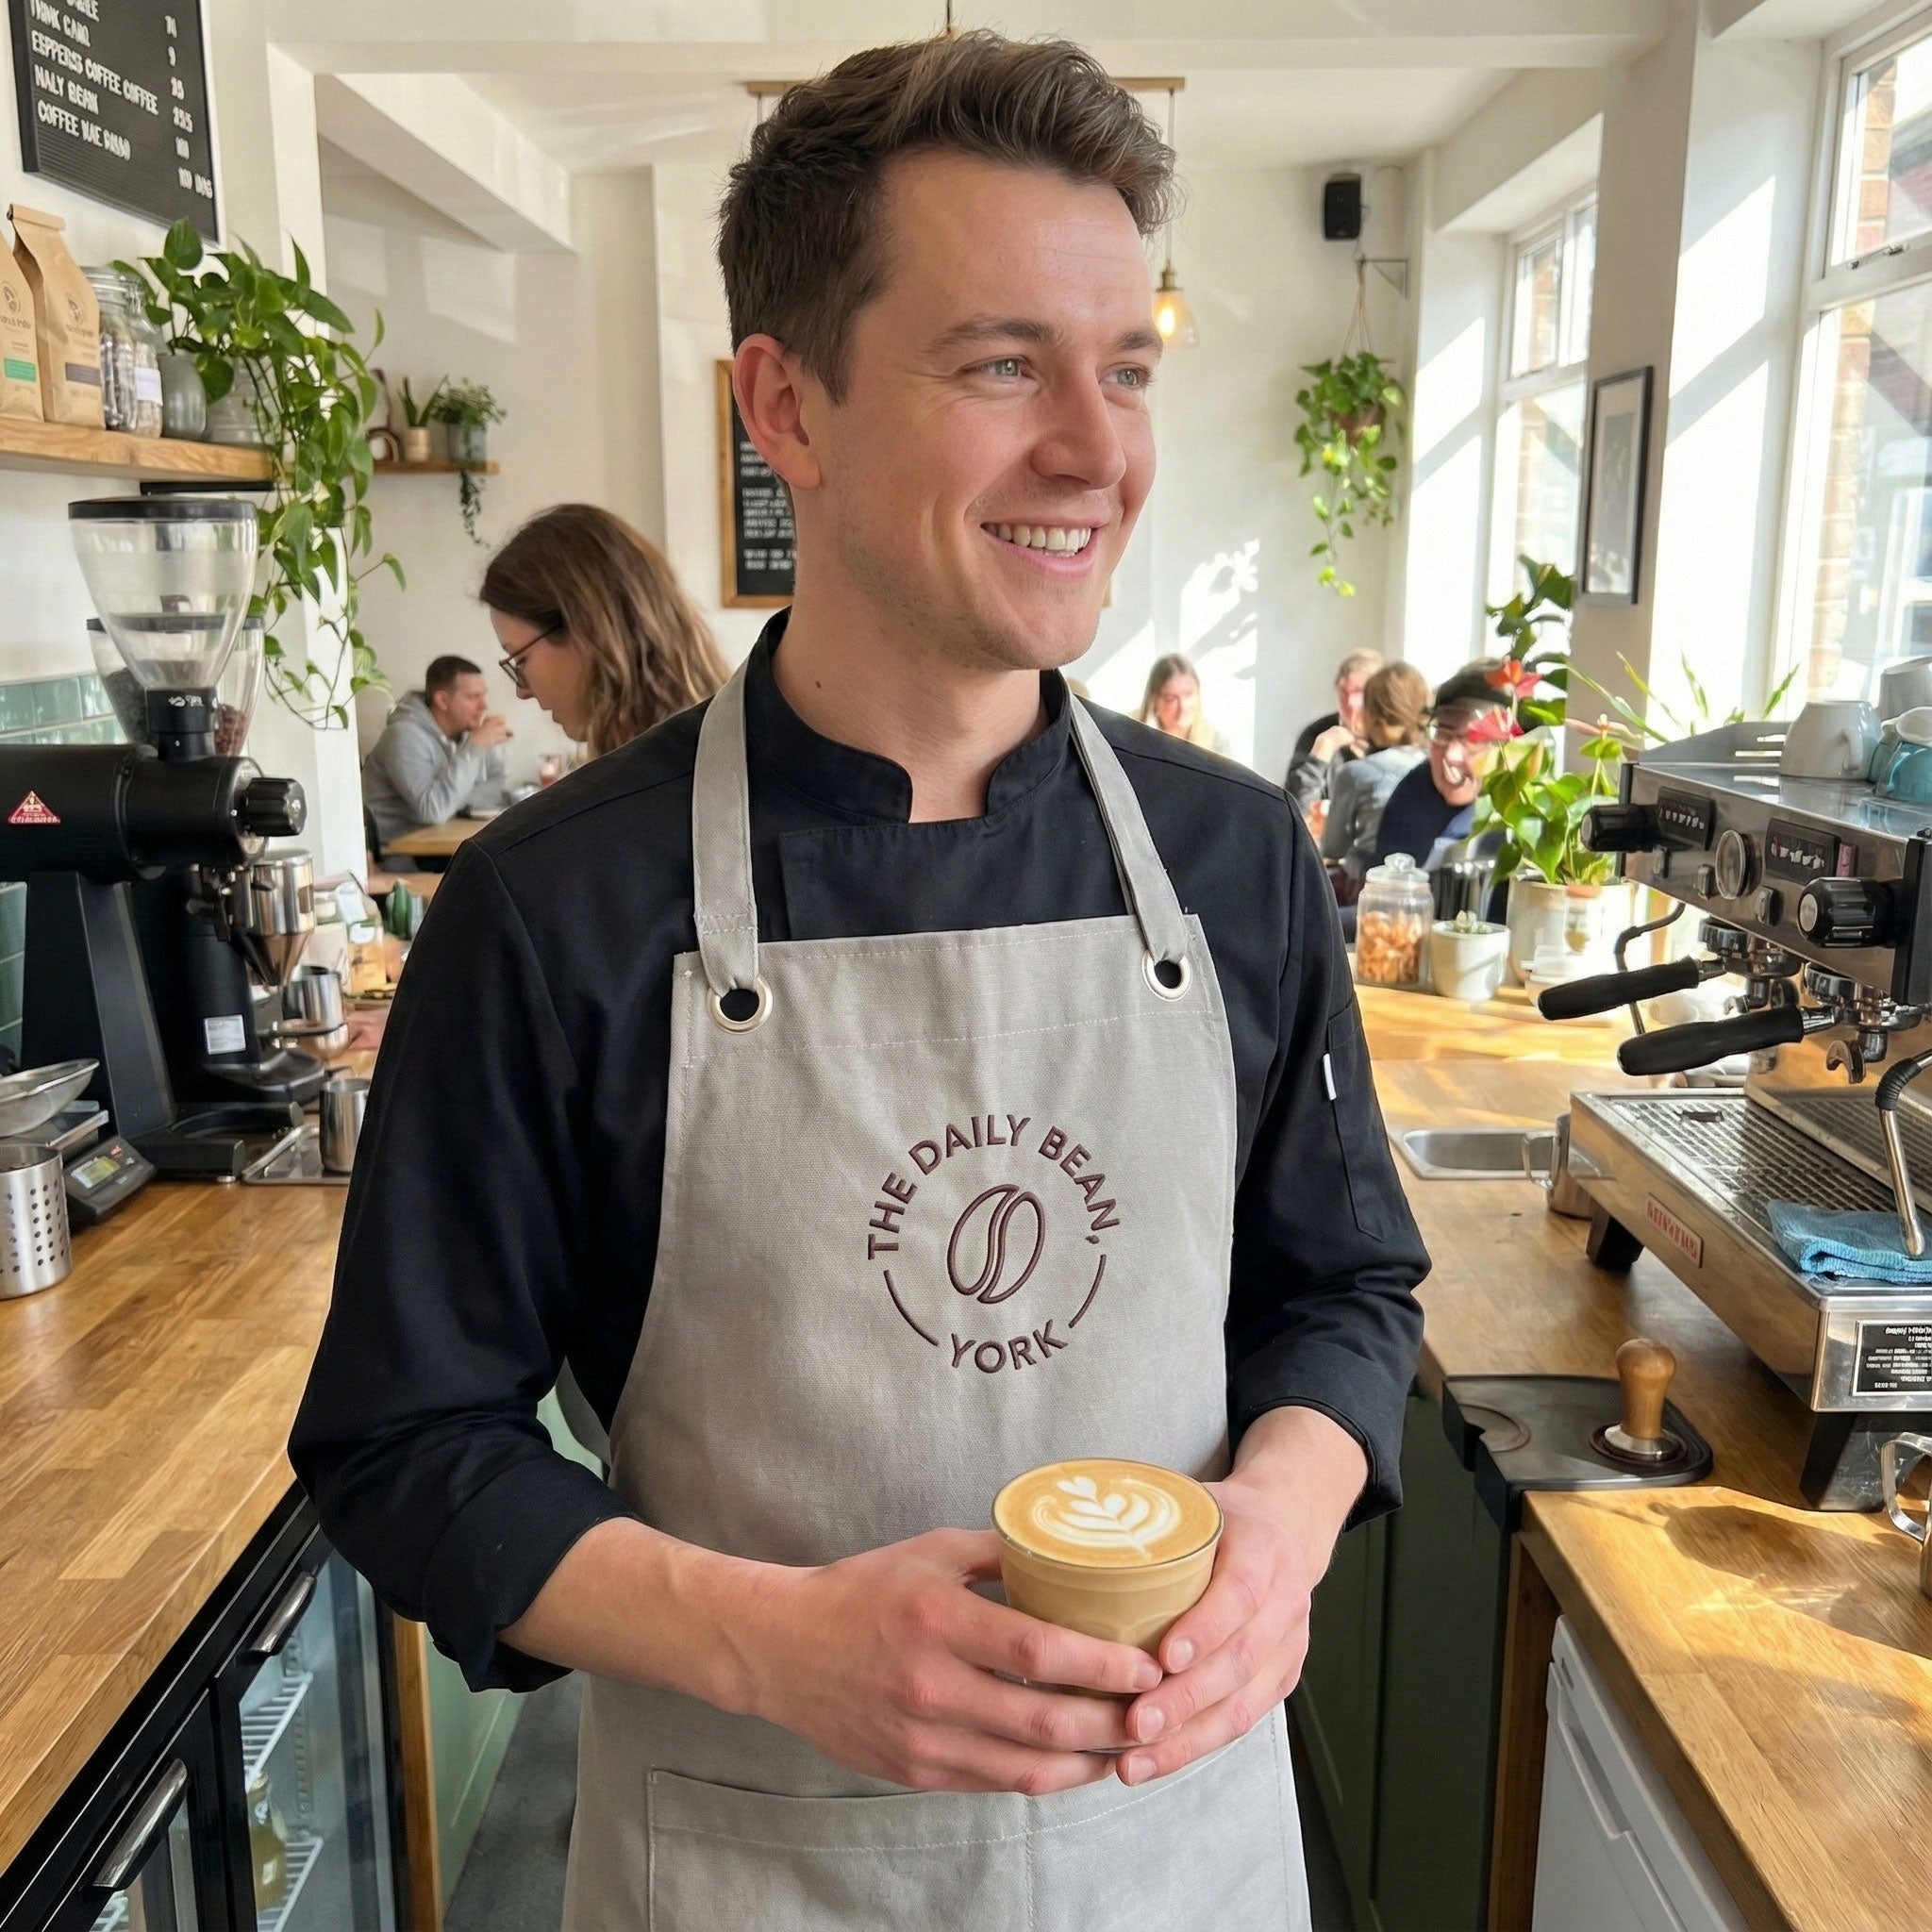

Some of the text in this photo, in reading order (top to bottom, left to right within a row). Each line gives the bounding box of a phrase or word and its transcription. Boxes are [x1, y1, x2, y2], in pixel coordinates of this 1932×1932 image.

[867, 1172, 918, 1260] THE
[908, 1114, 1031, 1175] DAILY
[951, 1319, 1069, 1374] YORK
